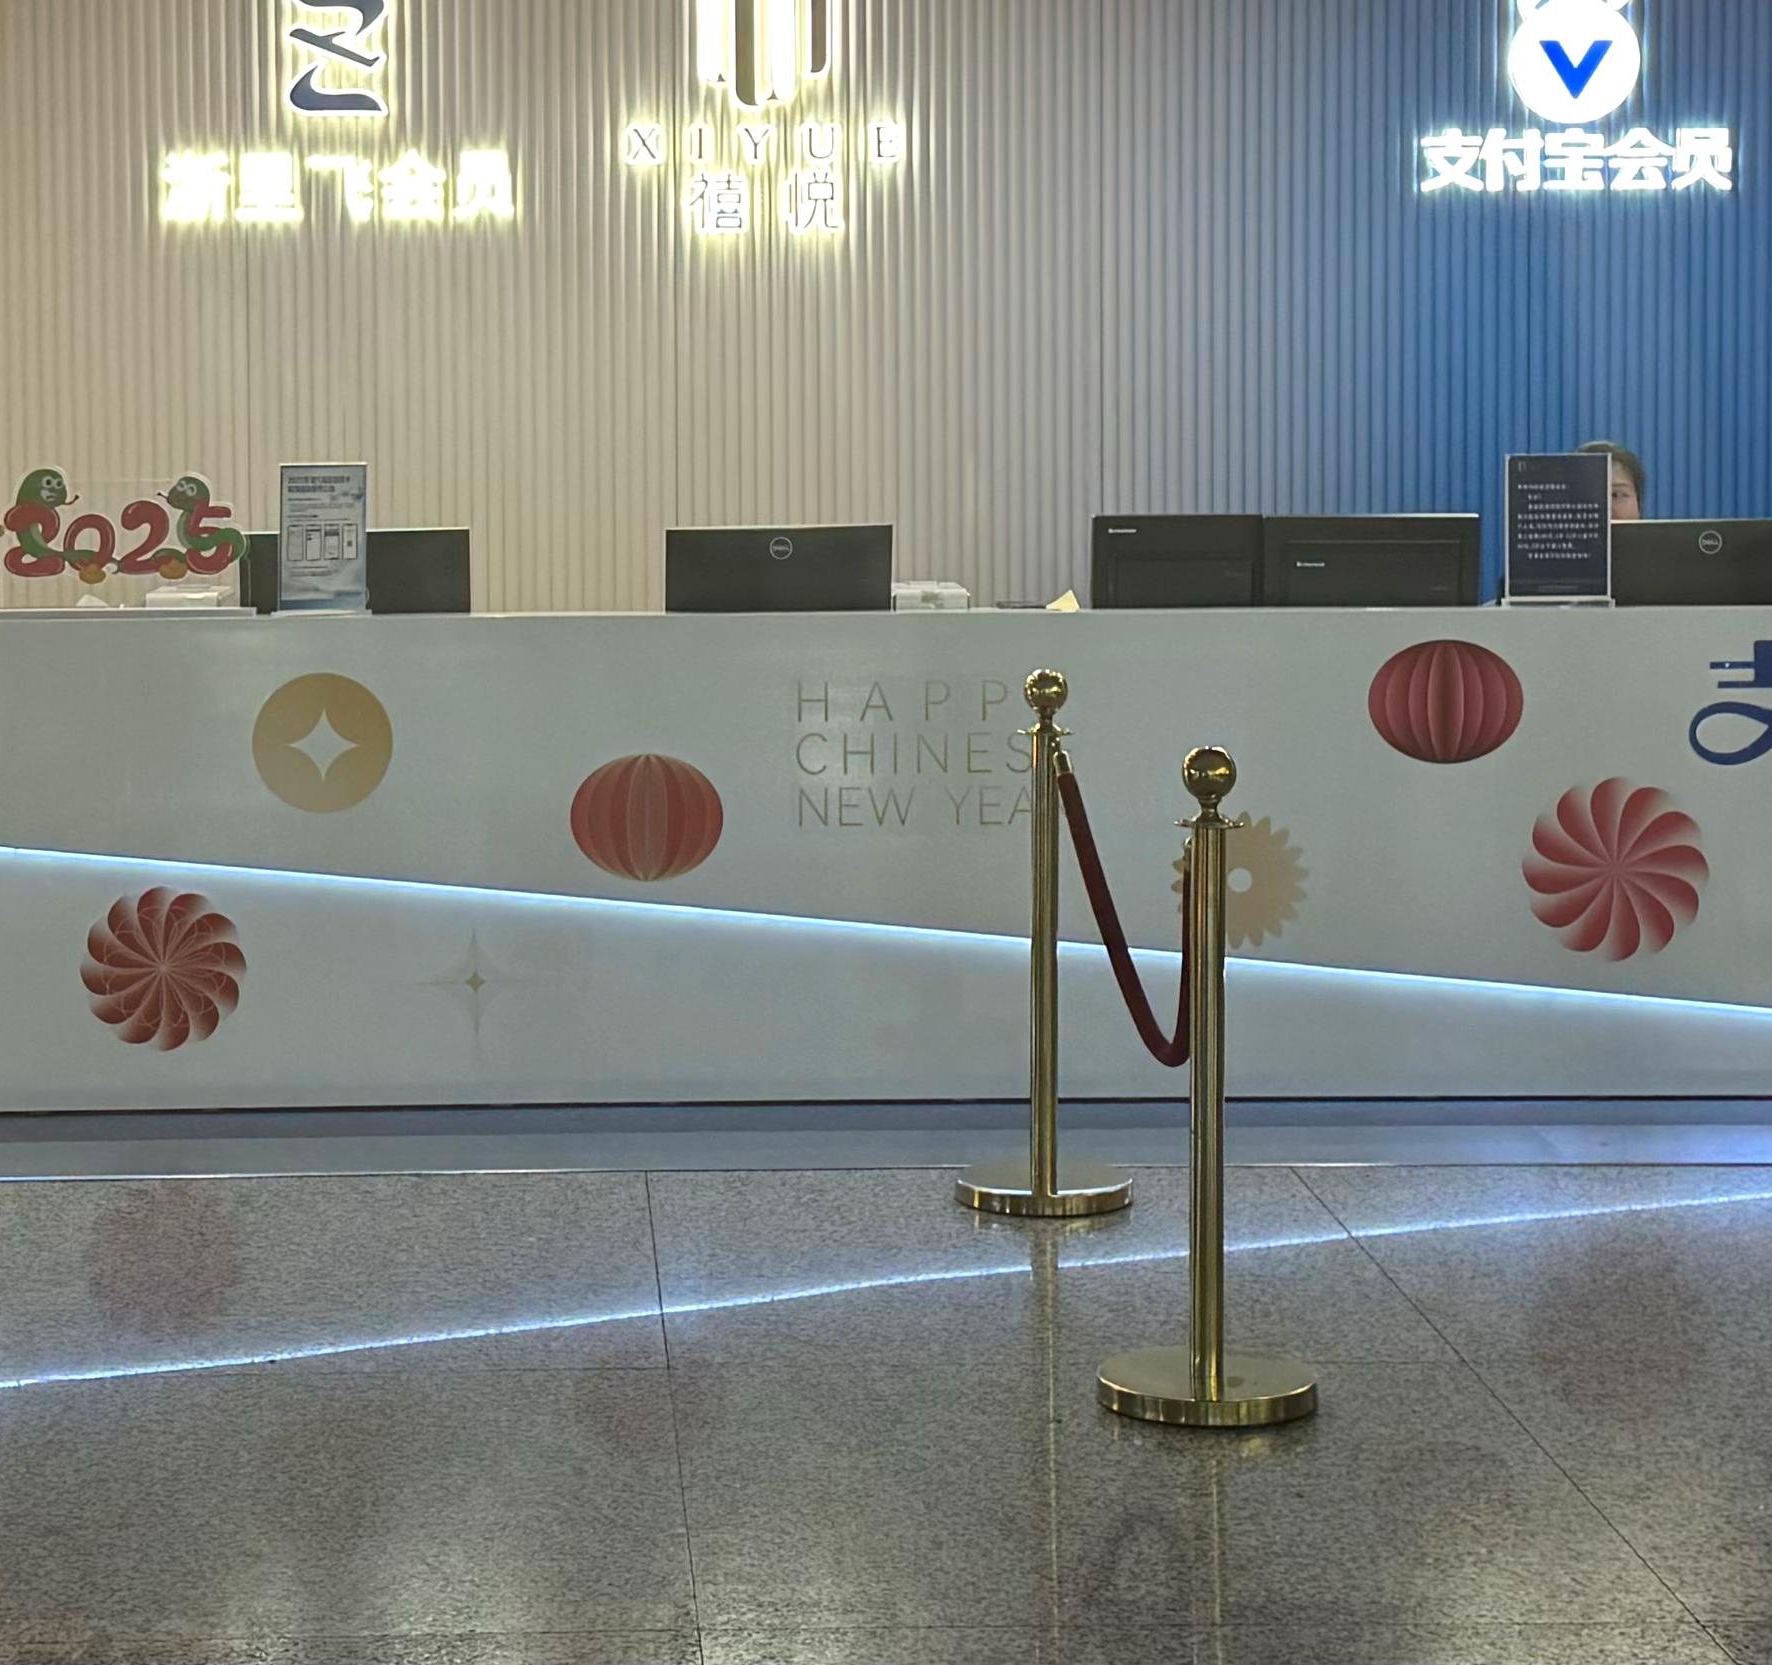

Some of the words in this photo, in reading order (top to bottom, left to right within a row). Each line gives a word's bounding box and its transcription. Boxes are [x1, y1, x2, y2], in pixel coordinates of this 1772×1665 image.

[1420, 128, 1732, 193] 支付宝会员
[688, 170, 841, 231] 禧悦
[3, 501, 243, 578] 2025
[796, 679, 1008, 723] HAPP
[795, 732, 1032, 775] CHINES
[798, 786, 915, 827] NEW
[945, 786, 1032, 826] YEA
